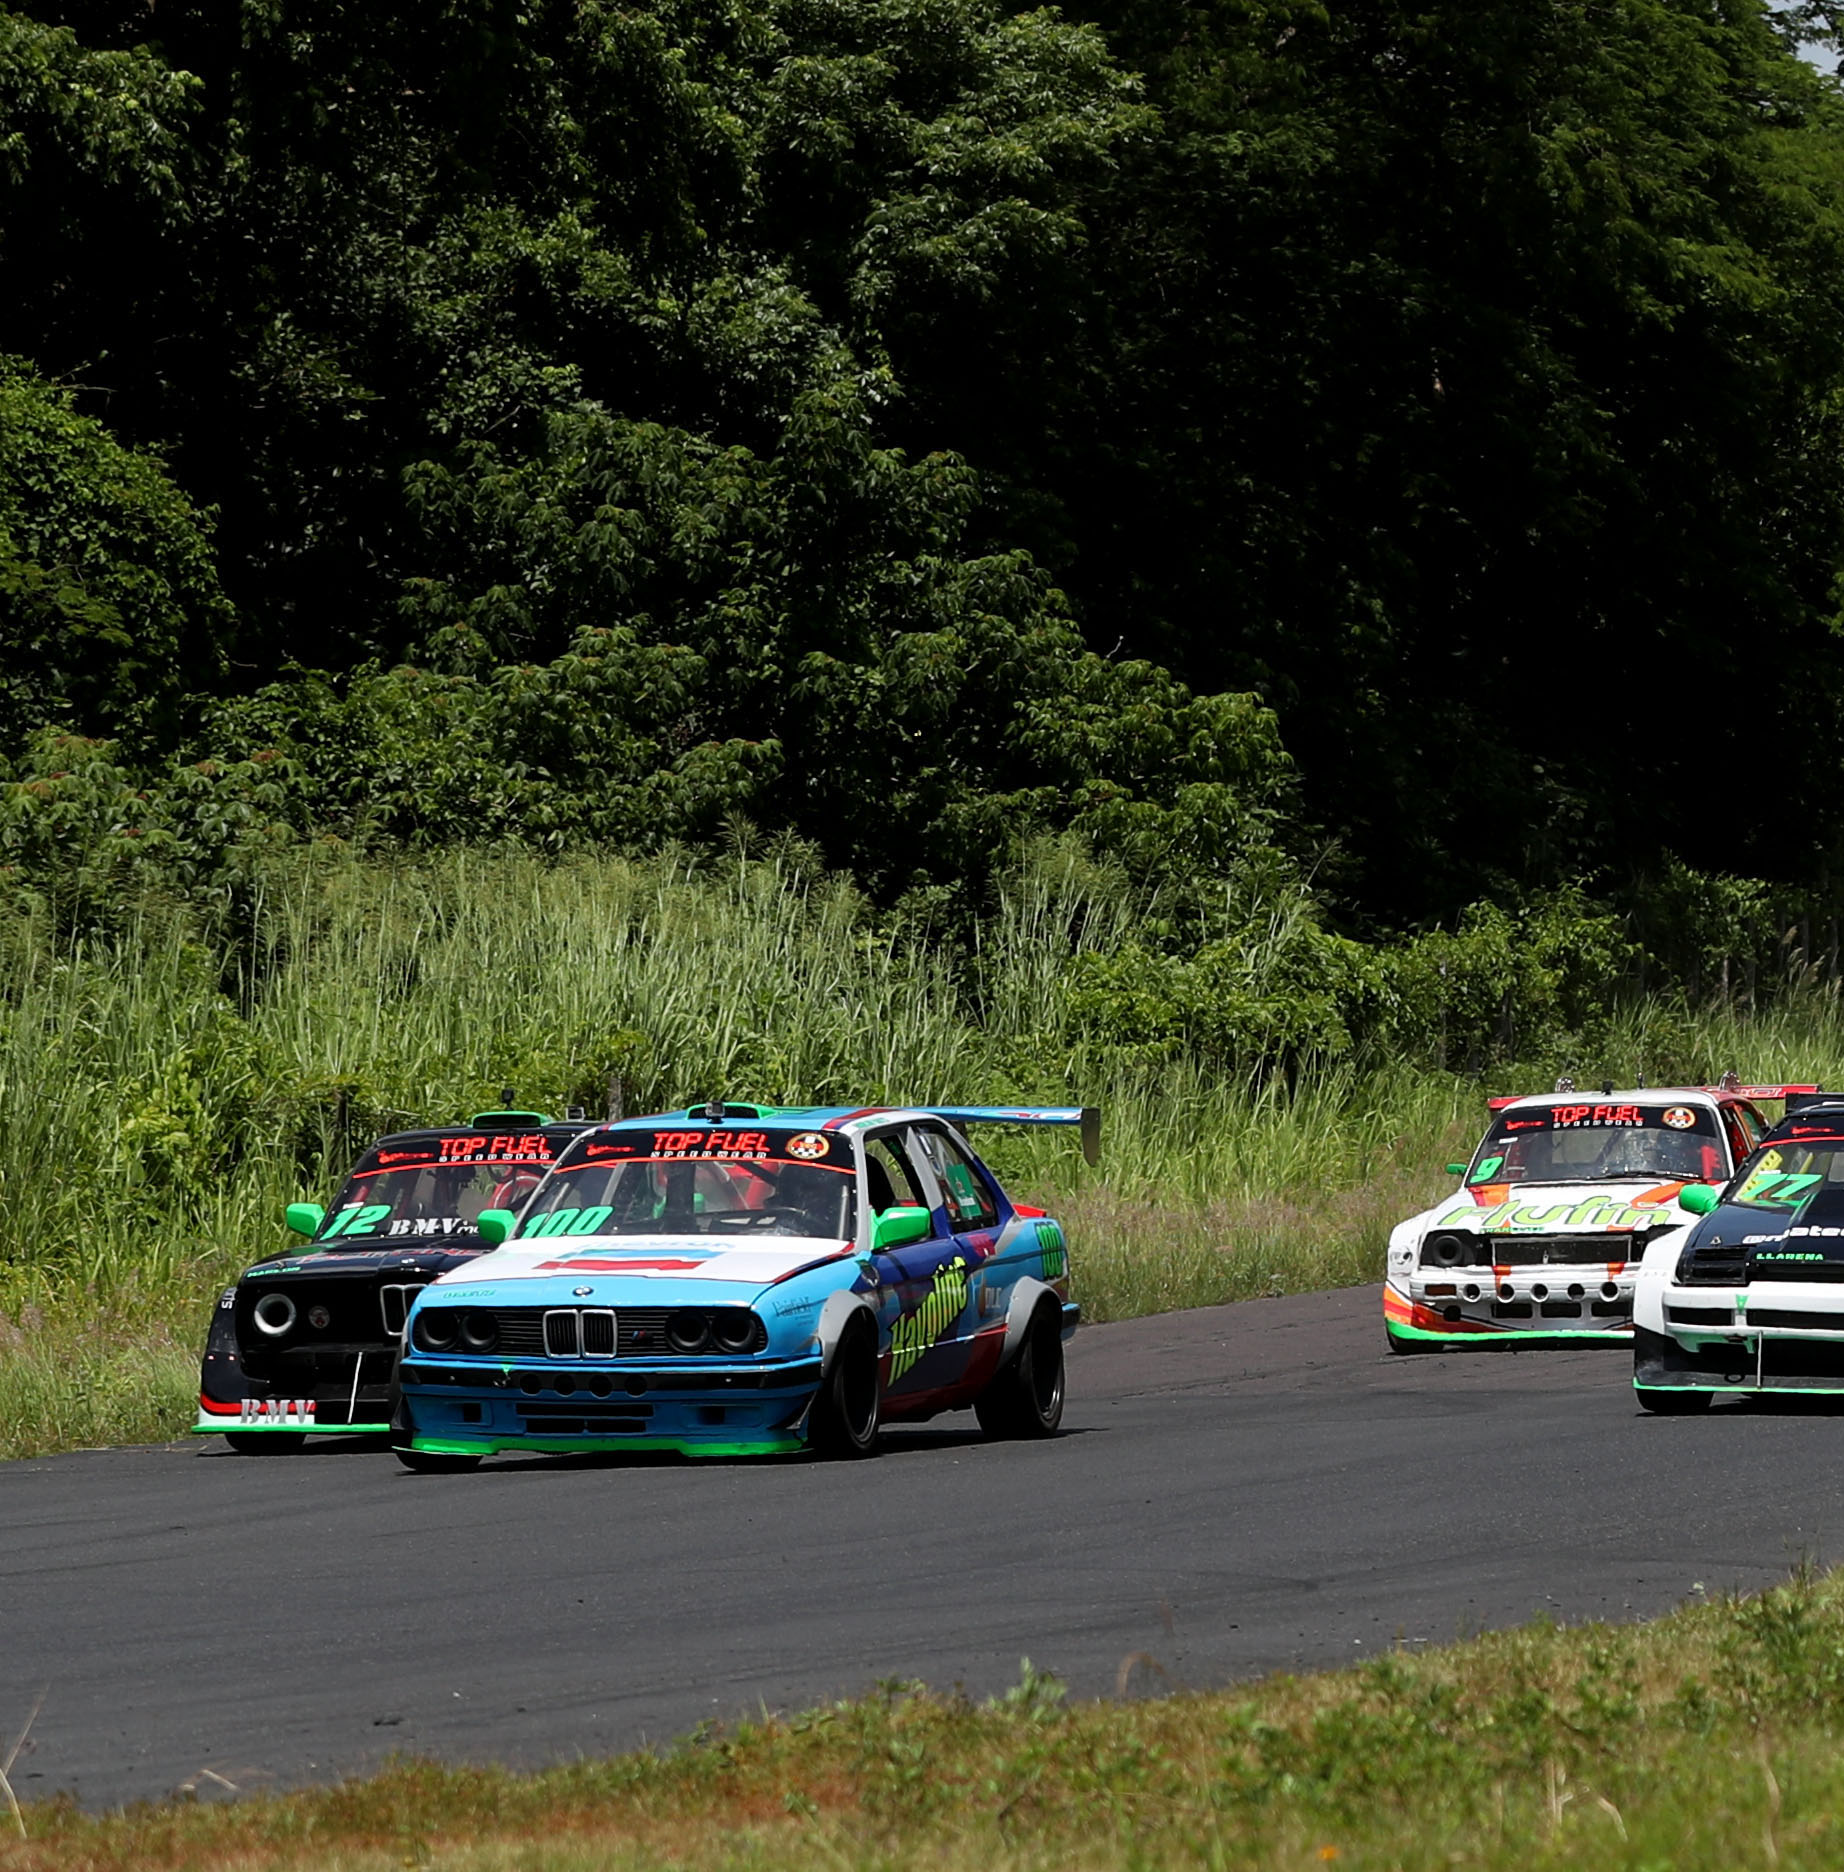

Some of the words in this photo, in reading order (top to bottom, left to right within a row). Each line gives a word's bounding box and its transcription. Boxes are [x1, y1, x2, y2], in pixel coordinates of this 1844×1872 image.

[1551, 1107, 1590, 1124] TOP
[1593, 1105, 1645, 1122] FUEL
[439, 1137, 487, 1156] TOP
[490, 1135, 553, 1154] FUEL
[653, 1132, 703, 1151] TOP
[705, 1132, 771, 1153] FUEL
[1469, 1156, 1504, 1184] 9
[1740, 1173, 1824, 1199] 77
[319, 1204, 393, 1241] 12
[516, 1206, 614, 1240] 100
